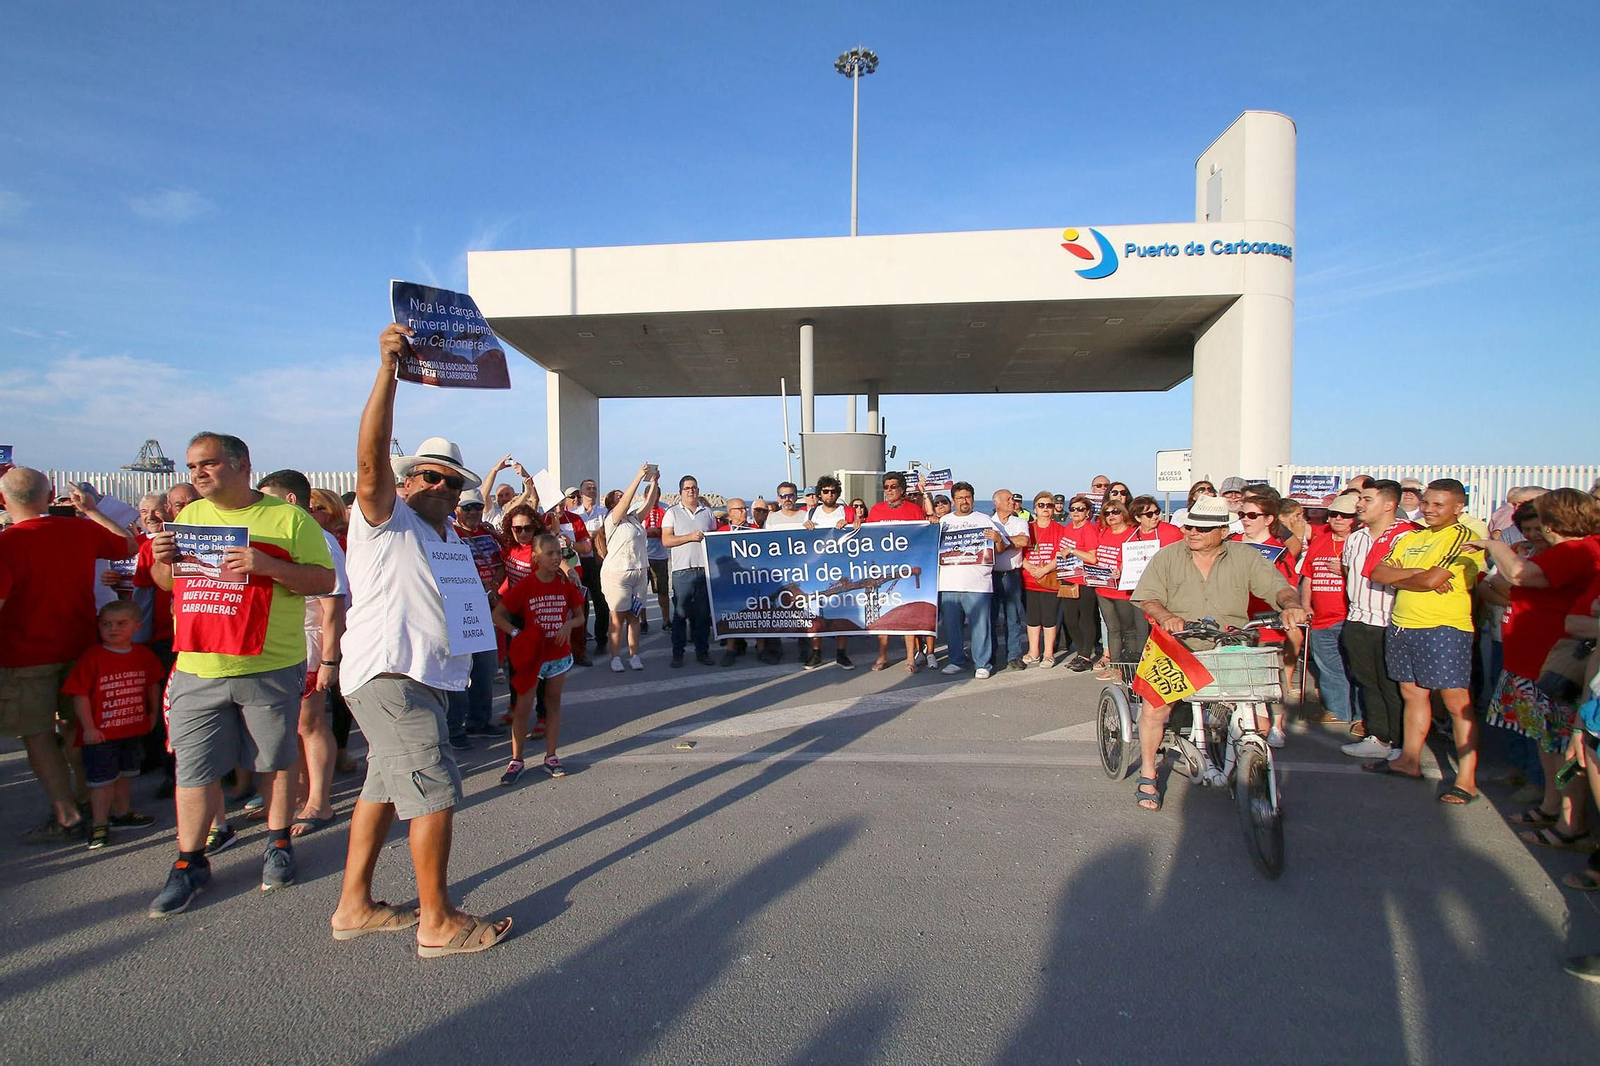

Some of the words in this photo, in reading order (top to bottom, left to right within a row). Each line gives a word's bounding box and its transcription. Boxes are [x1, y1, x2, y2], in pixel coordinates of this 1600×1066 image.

[1124, 242, 1179, 258] Puerto
[1184, 241, 1204, 256] de
[1210, 239, 1293, 262] Carboneras
[436, 302, 446, 315] la
[449, 306, 475, 320] carga
[408, 317, 449, 331] mineral
[452, 321, 464, 332] de
[413, 337, 426, 346] en
[430, 335, 490, 351] Carboneras
[730, 539, 761, 559] No
[768, 544, 782, 556] a
[787, 537, 807, 555] la
[813, 537, 874, 557] carga
[880, 532, 908, 552] de
[432, 551, 468, 561] ASOCIACION
[732, 563, 809, 585] mineral
[816, 562, 842, 581] de
[849, 561, 912, 580] hierro
[186, 579, 244, 591] PLATAFORMA
[183, 591, 221, 601] MUEVETE
[222, 593, 242, 603] POR
[745, 594, 771, 610] en
[778, 589, 903, 609] Carboneras
[182, 603, 238, 616] CARBONERAS
[464, 603, 473, 611] DE
[463, 616, 480, 624] AGUA
[722, 611, 762, 621] PLATAFORMA
[762, 611, 771, 619] DE
[772, 610, 817, 619] ASOCIACIONES
[728, 620, 757, 629] MUEVETE
[758, 620, 771, 628] POR
[771, 619, 813, 628] CARBONERAS
[462, 629, 484, 638] MARGA
